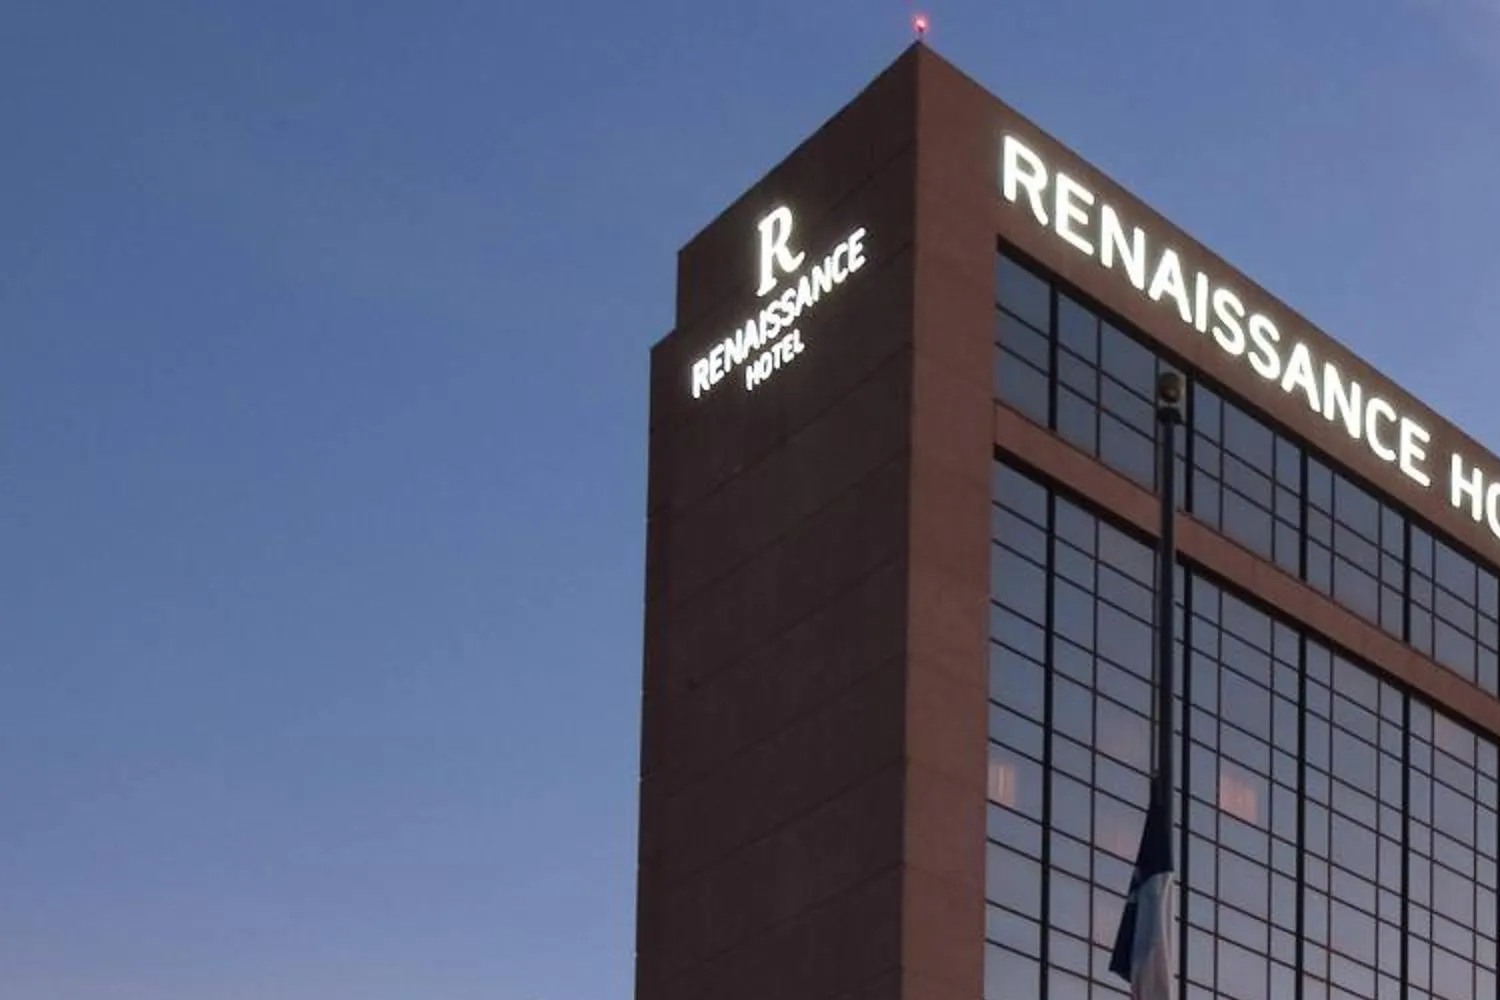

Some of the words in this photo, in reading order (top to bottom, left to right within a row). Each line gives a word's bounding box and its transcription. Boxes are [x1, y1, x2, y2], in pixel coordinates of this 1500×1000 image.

[691, 227, 866, 399] RENAISSANCE
[756, 204, 806, 298] R
[1002, 134, 1431, 488] RENAISSANCE
[745, 328, 805, 391] HOTEL
